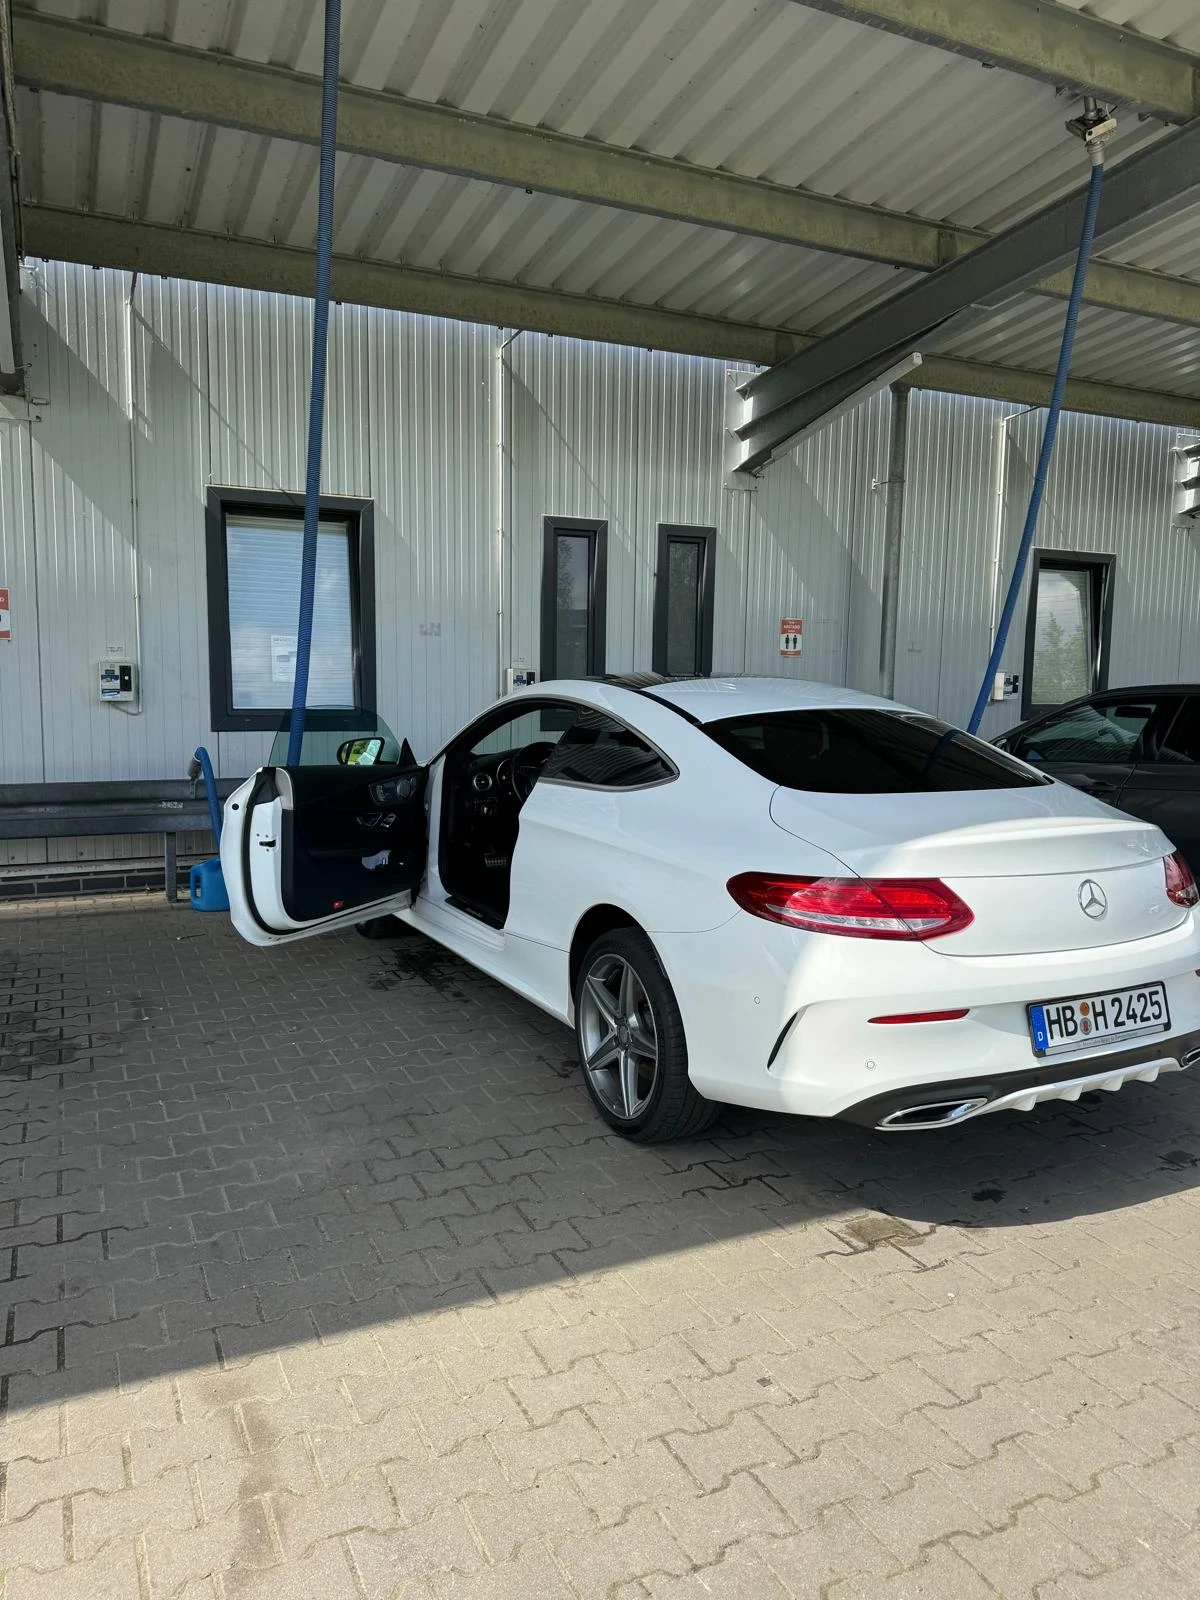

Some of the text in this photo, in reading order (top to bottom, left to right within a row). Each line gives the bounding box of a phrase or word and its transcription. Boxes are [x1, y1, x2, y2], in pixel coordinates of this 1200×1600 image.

[1046, 990, 1162, 1039] HB H 2425
[1037, 1031, 1044, 1042] D
